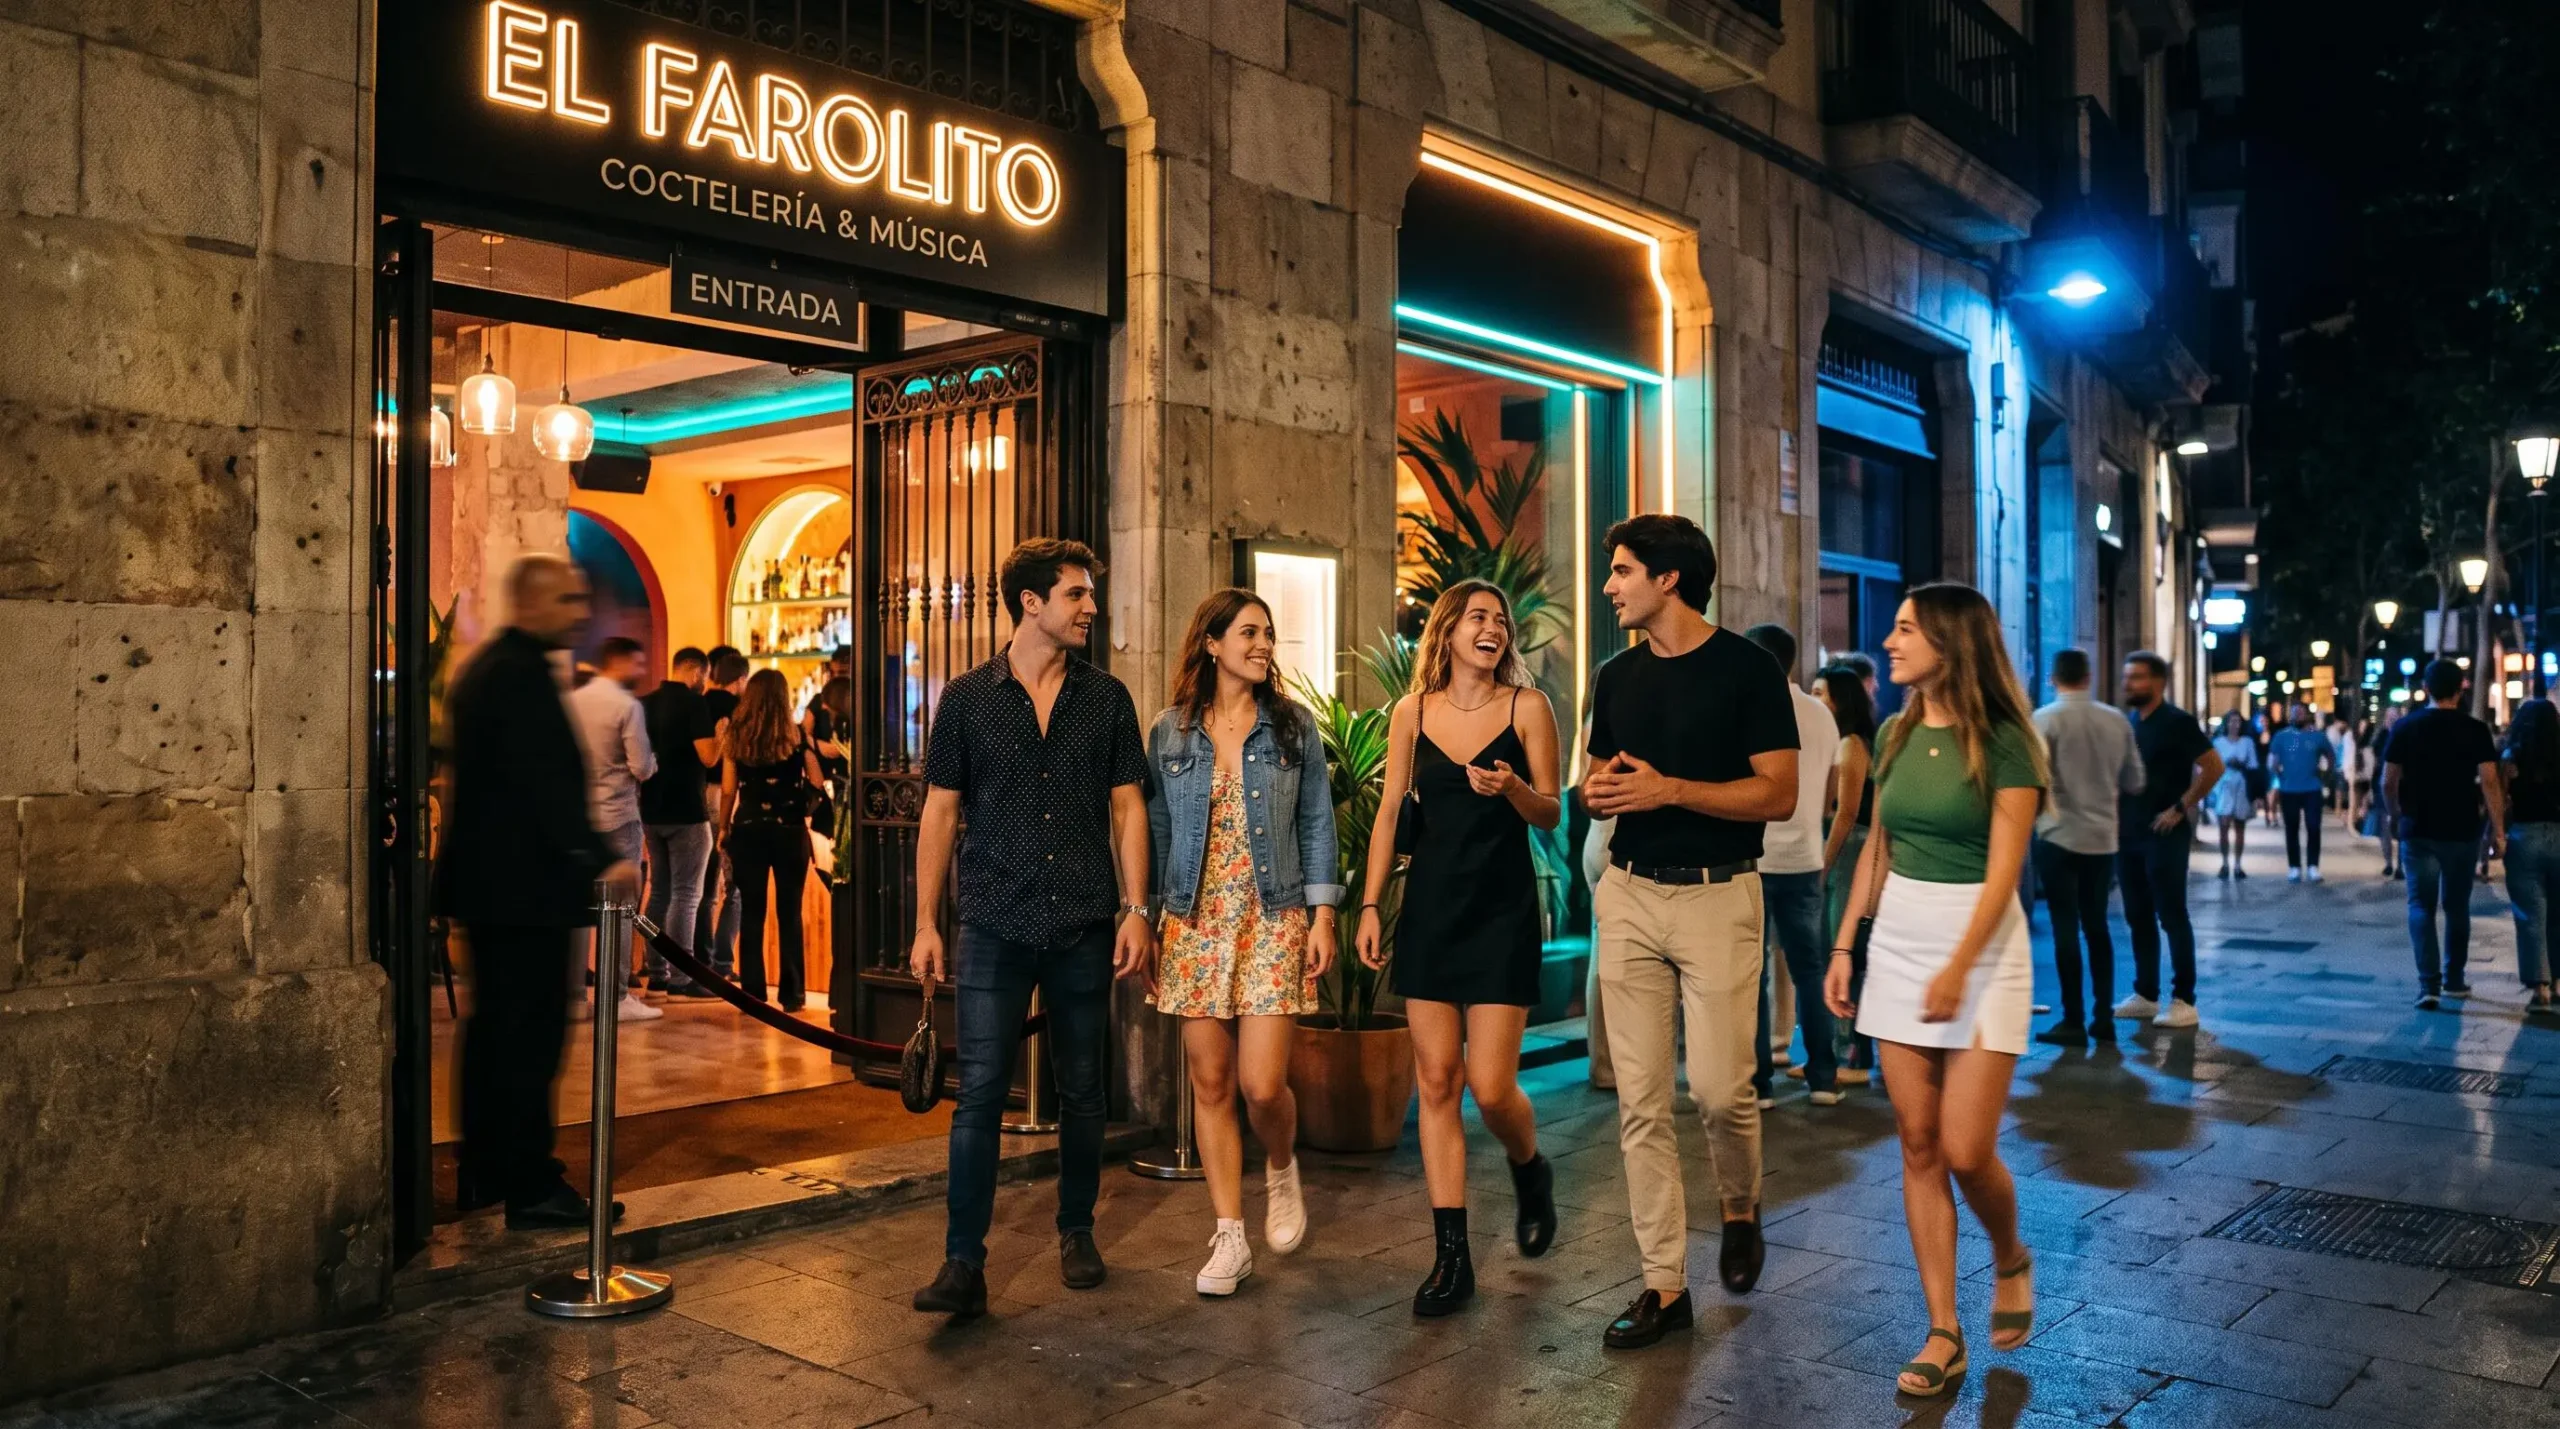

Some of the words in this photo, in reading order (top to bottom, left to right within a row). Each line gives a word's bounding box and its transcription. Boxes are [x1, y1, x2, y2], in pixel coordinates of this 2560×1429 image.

[486, 0, 611, 126] EL
[640, 41, 1062, 229] FAROLITO
[600, 157, 827, 235] COCTELERÍA
[837, 209, 860, 241] &
[870, 215, 989, 269] MÚSICA
[690, 272, 843, 327] ENTRADA
